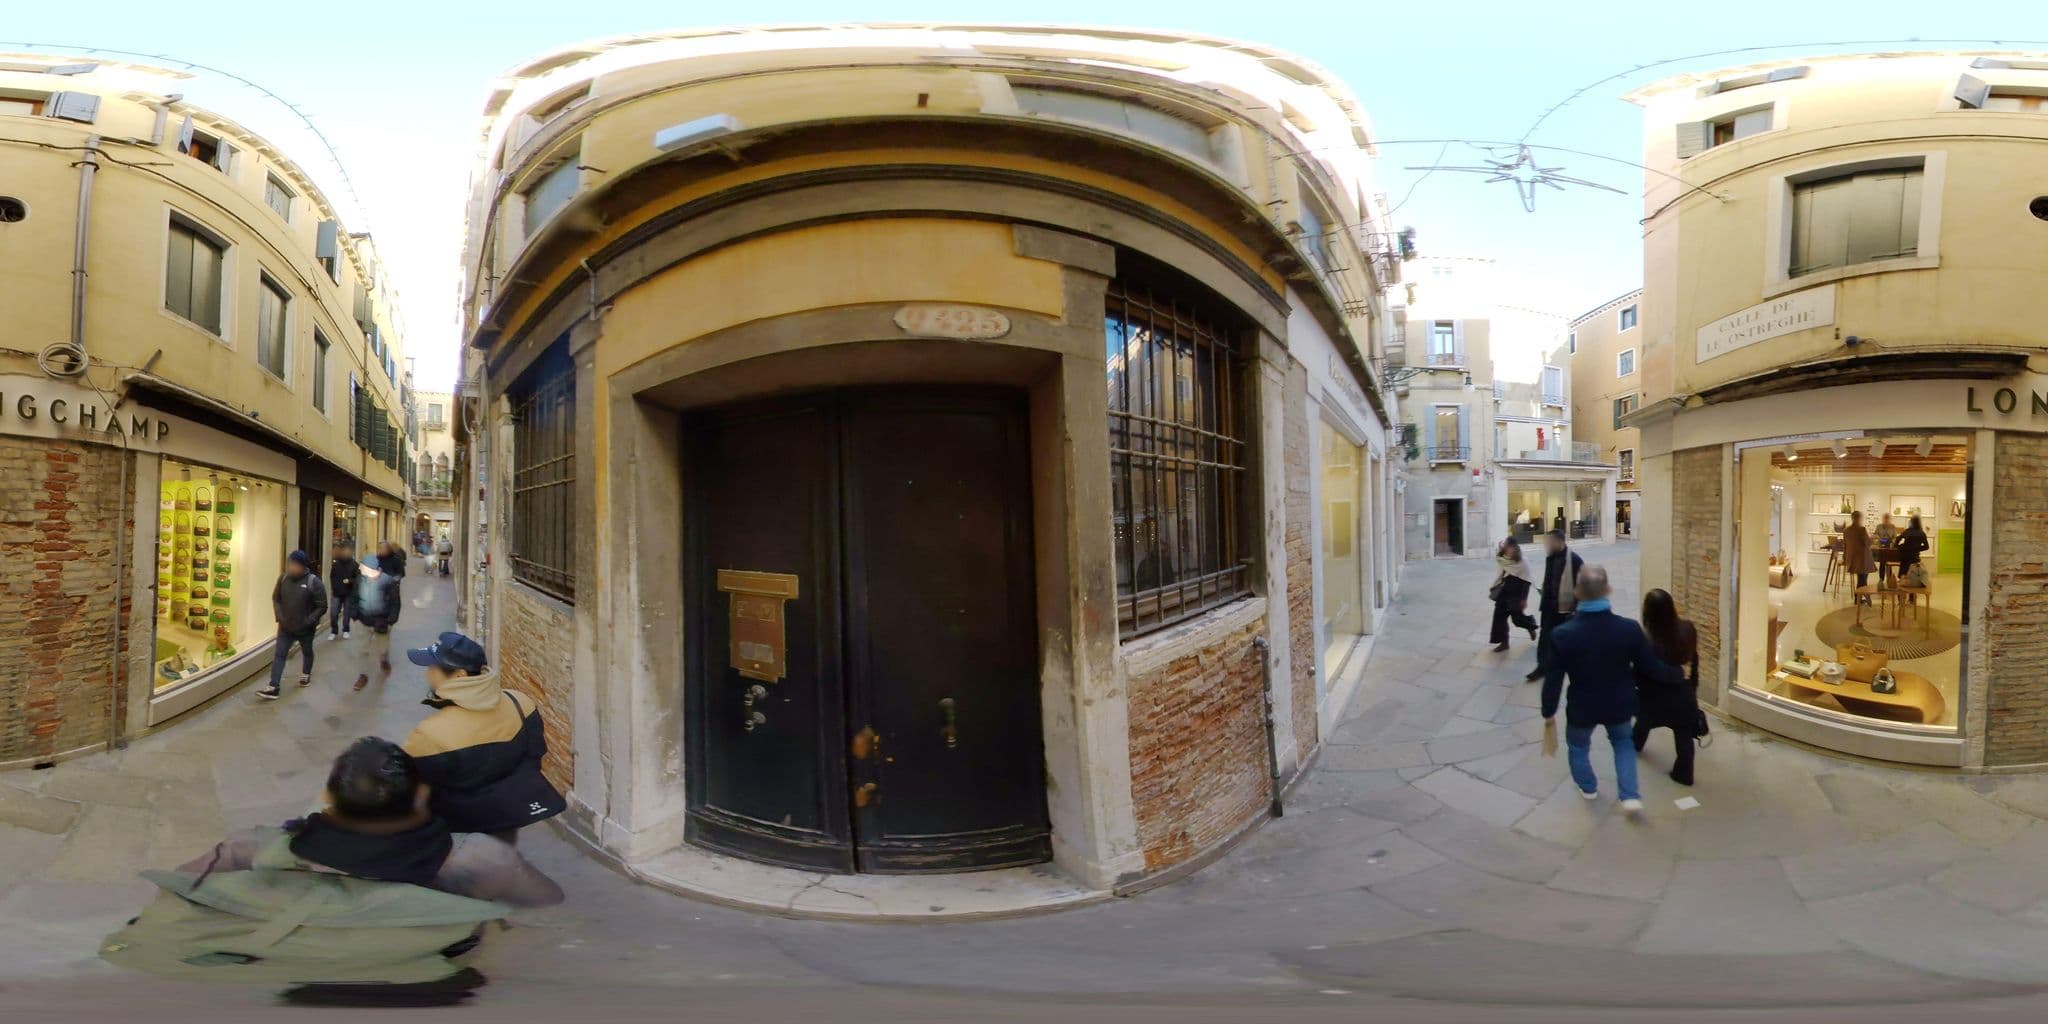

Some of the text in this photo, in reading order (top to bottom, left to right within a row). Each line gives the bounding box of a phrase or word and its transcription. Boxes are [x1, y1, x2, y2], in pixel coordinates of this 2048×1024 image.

[1706, 310, 1816, 353] LE OSTREGHE
[1719, 300, 1795, 333] CALLE DE
[0, 392, 170, 441] GCHAMP
